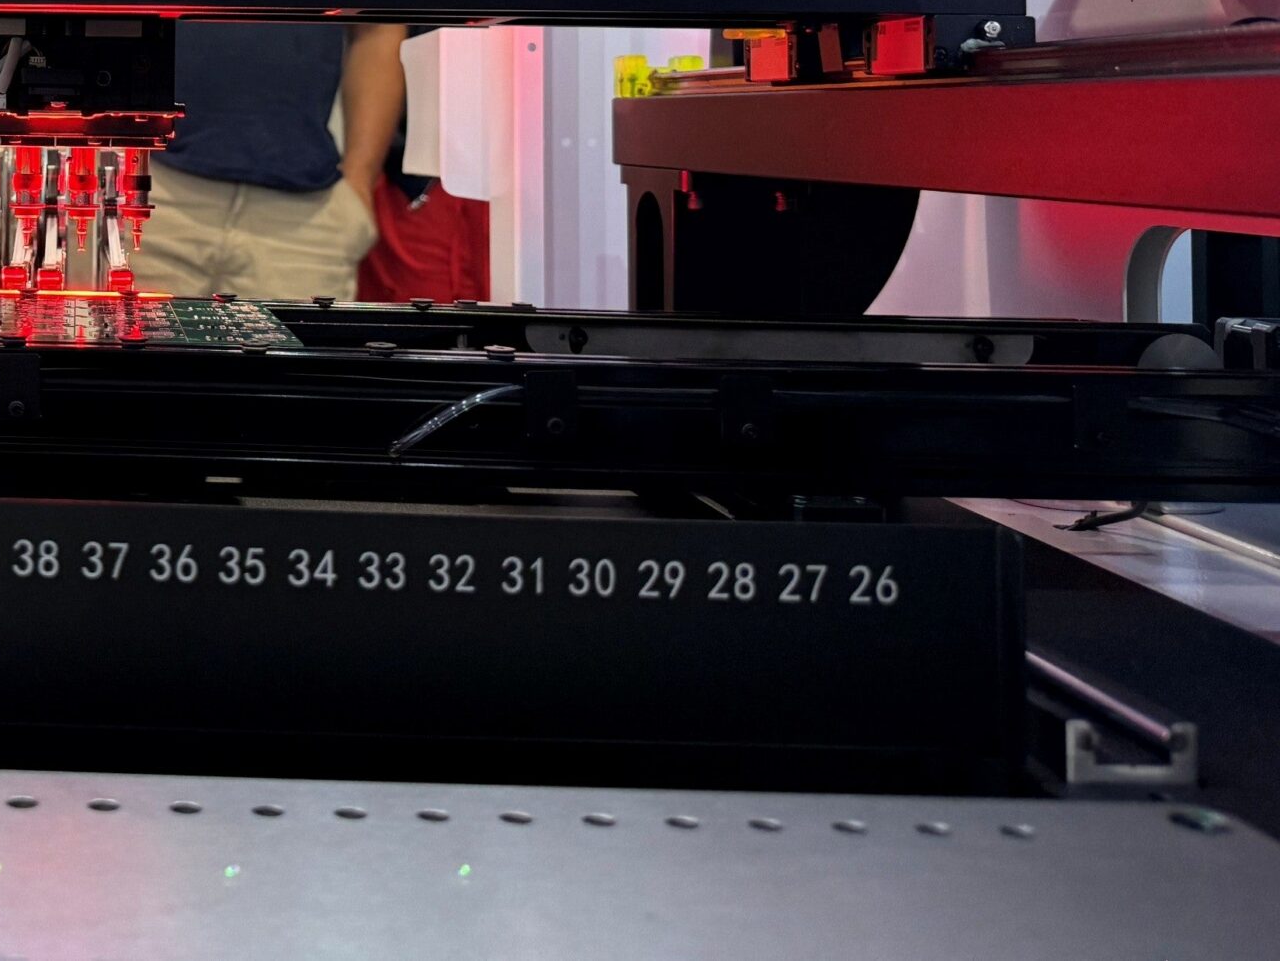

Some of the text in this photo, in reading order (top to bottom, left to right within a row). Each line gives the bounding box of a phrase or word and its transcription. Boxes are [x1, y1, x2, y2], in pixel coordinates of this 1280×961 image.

[13, 539, 59, 577] 38
[82, 541, 128, 578] 37
[150, 543, 197, 582] 36
[219, 546, 265, 585] 35
[288, 548, 337, 586] 34
[359, 551, 405, 590] 33
[429, 553, 475, 592] 32
[502, 556, 542, 594] 31
[569, 558, 615, 596] 30
[638, 559, 685, 598] 29
[708, 561, 755, 600] 28
[778, 564, 826, 601] 27
[849, 565, 897, 603] 26
